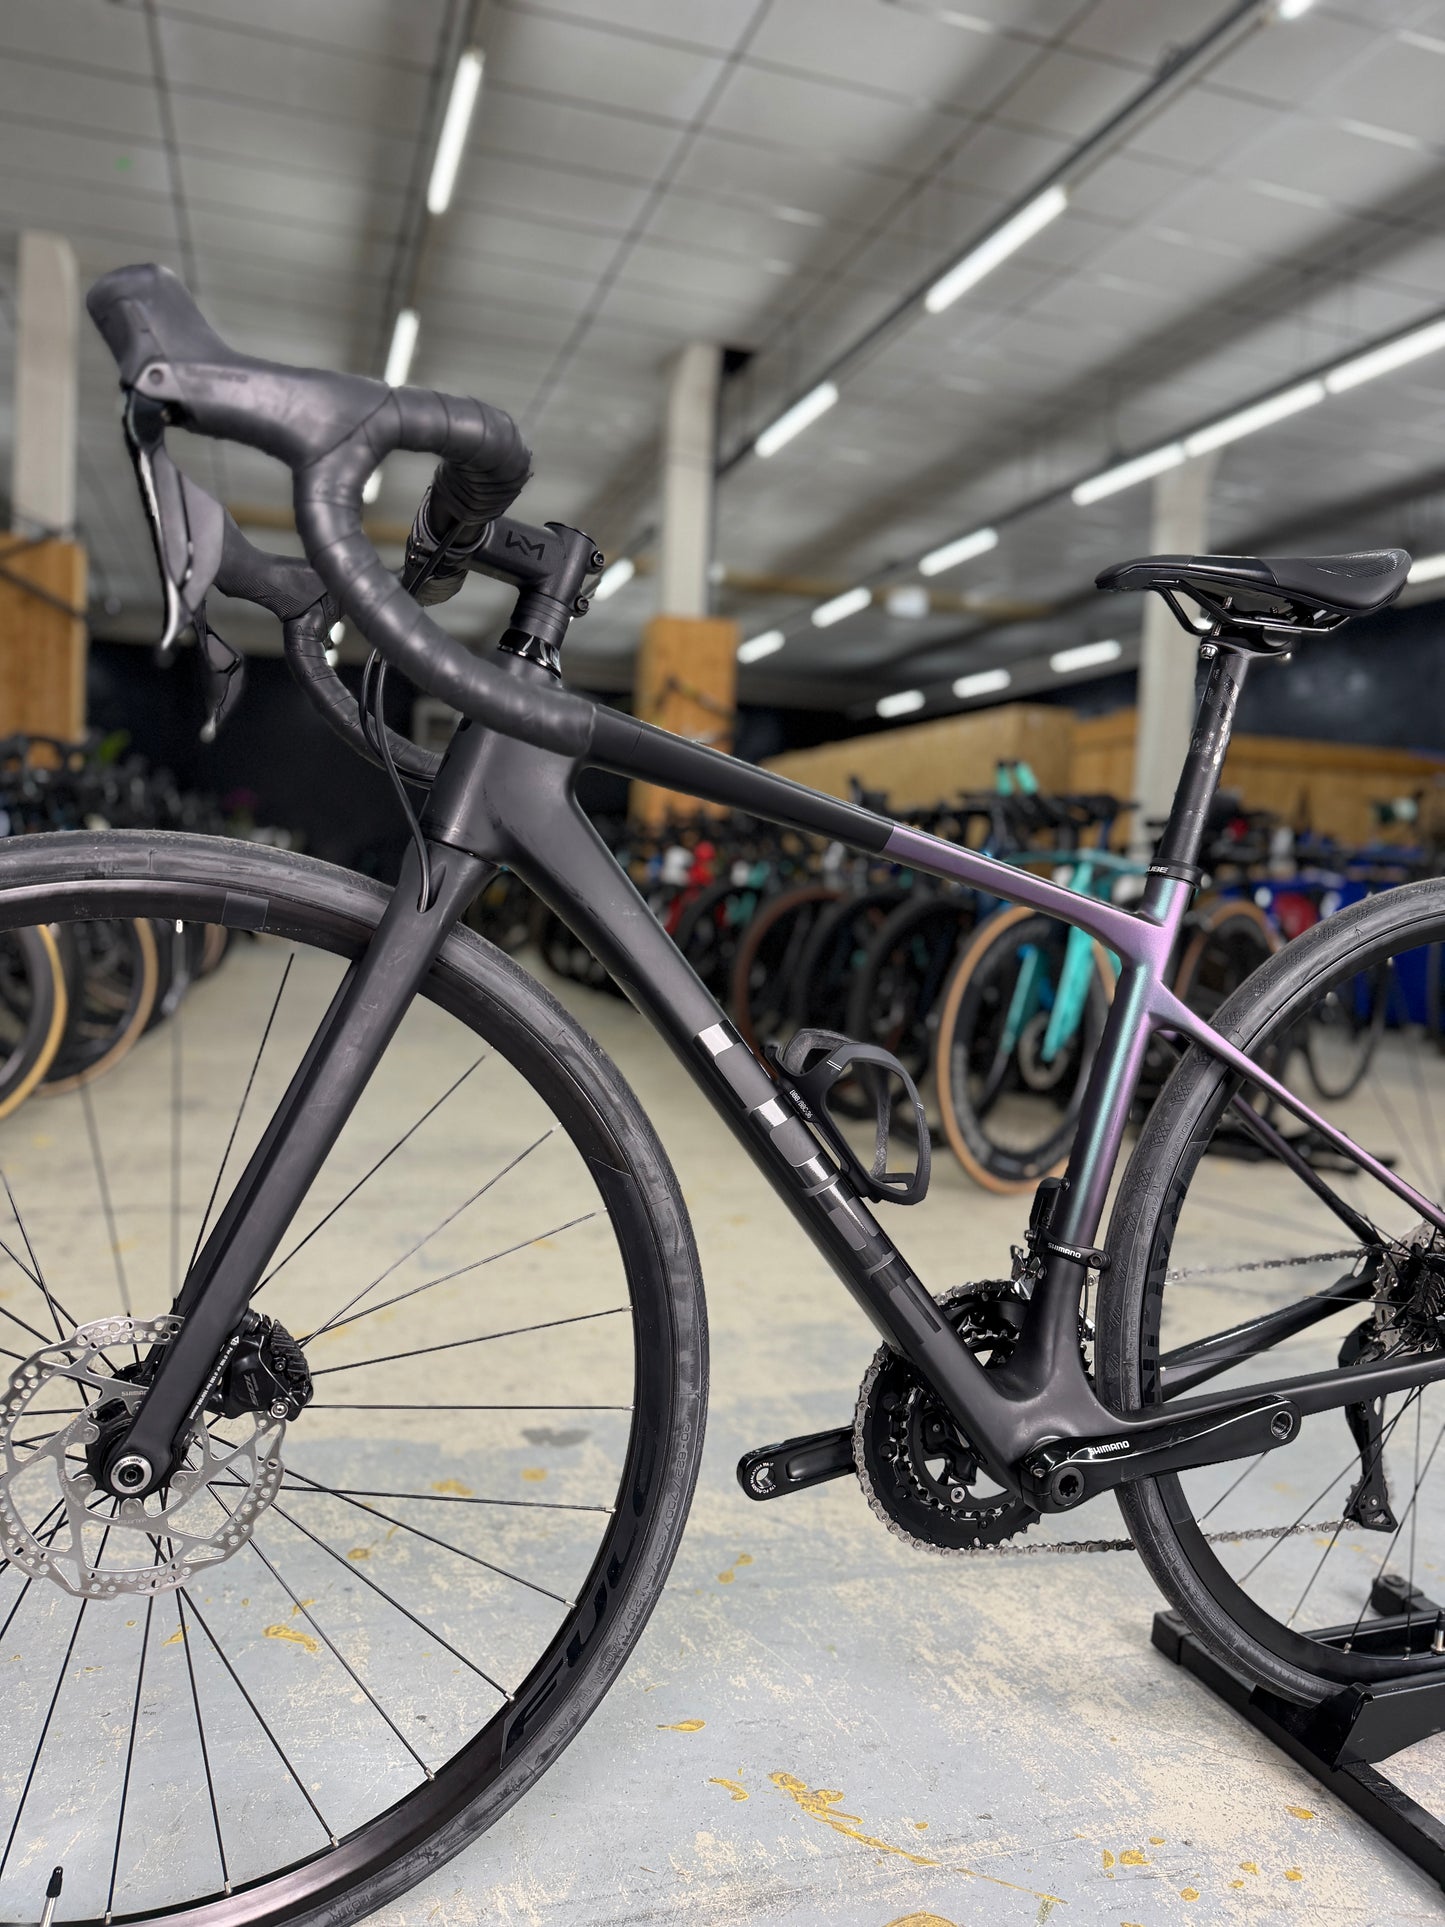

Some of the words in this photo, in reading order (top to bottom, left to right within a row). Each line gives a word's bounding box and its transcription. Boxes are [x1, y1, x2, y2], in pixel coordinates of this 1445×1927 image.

[1148, 865, 1169, 874] UBE
[1047, 1242, 1082, 1259] SHIMANO
[1089, 1440, 1130, 1456] SHIMANO
